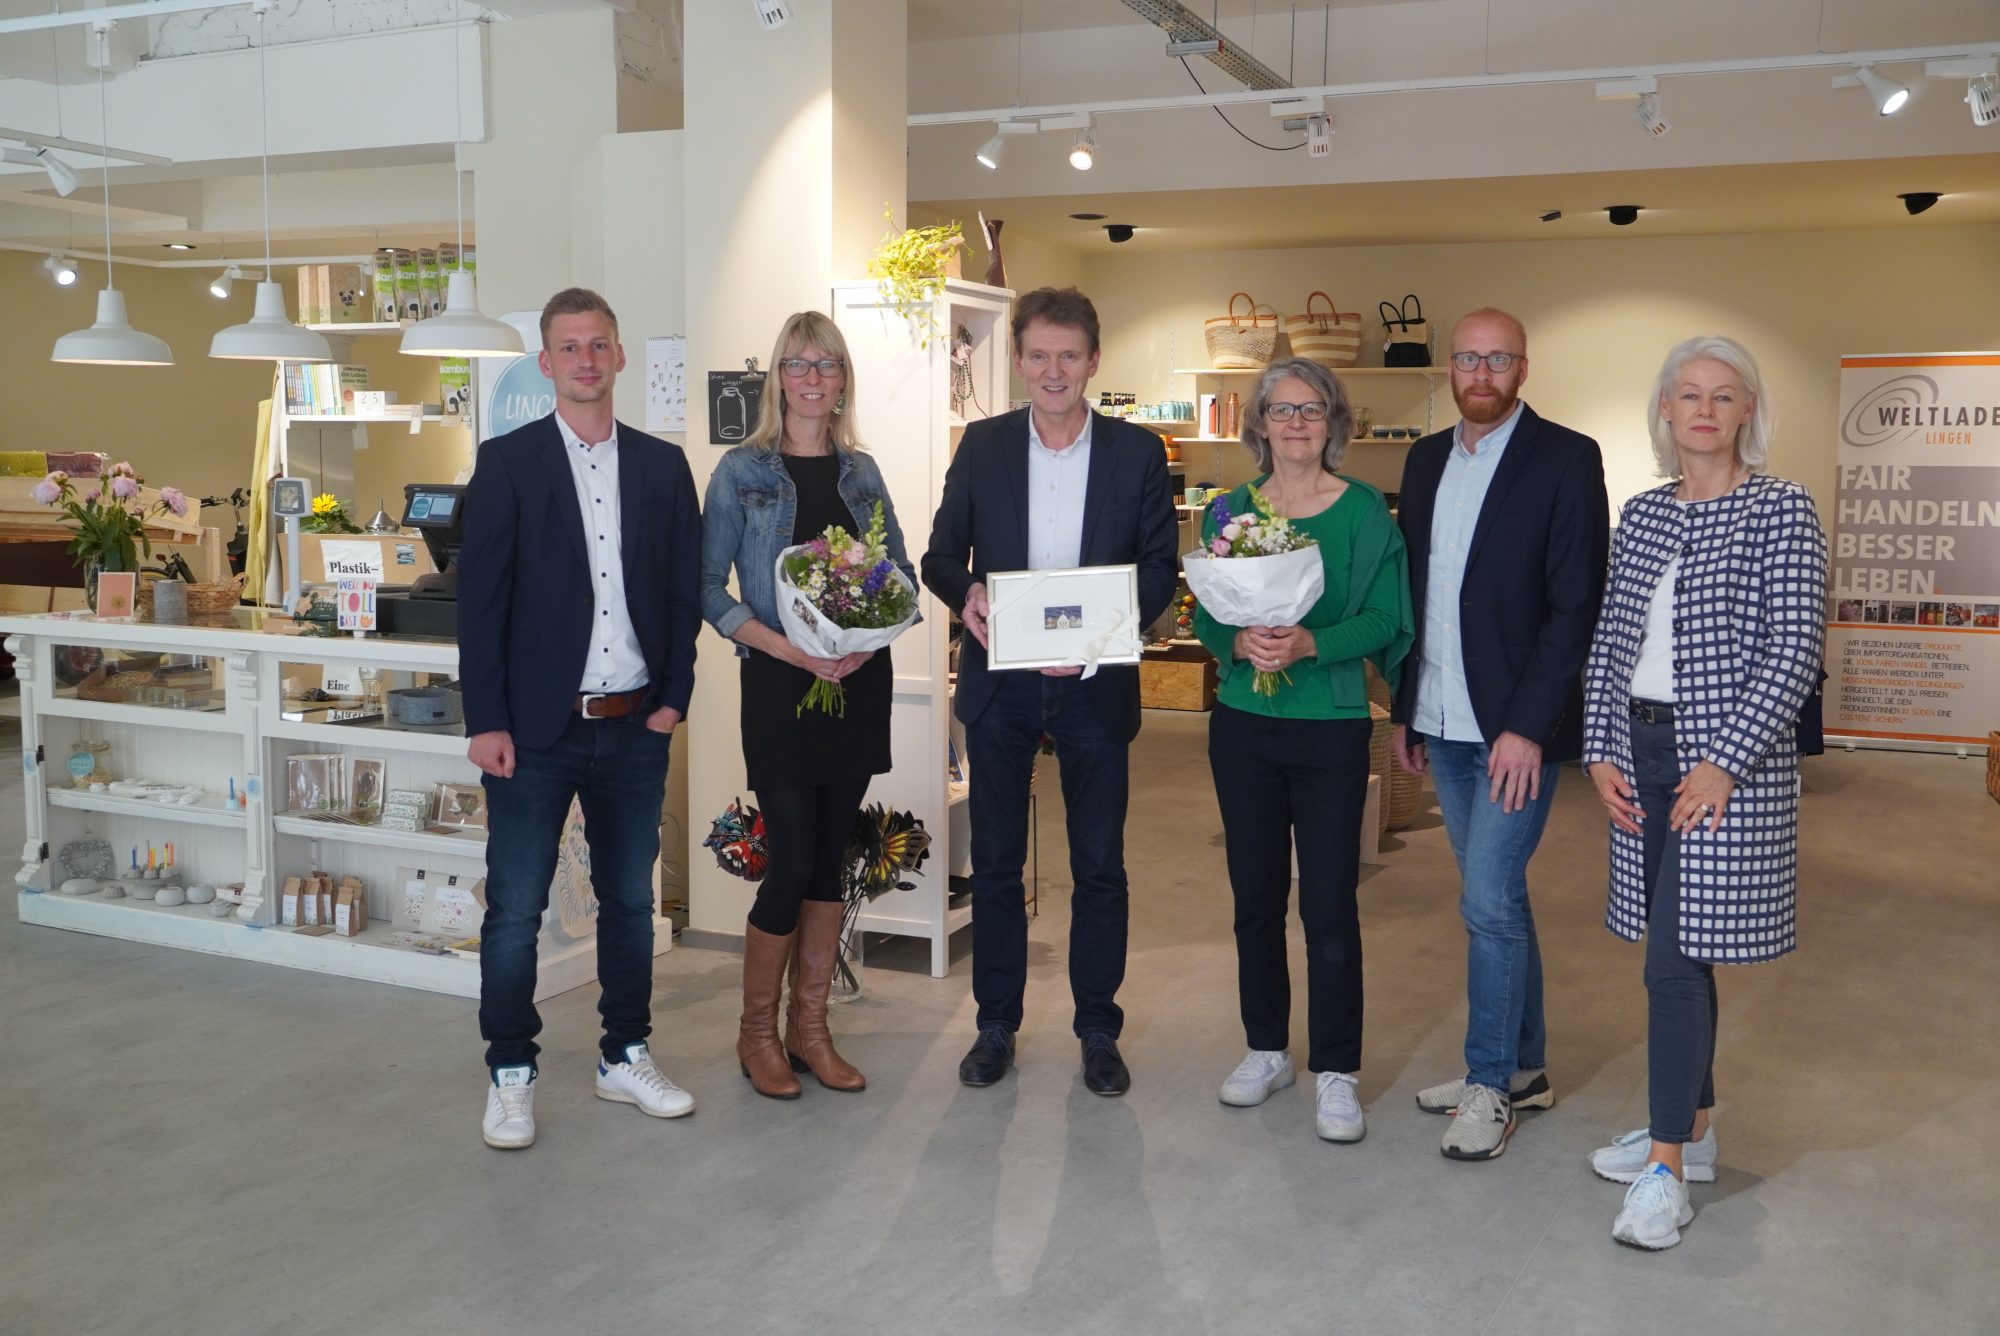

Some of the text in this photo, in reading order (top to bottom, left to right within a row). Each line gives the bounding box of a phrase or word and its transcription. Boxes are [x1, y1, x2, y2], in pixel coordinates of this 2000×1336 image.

[1878, 406, 2000, 426] WELTLADE
[1925, 432, 1971, 445] LINGEN
[1840, 464, 1912, 490] FAIR
[1838, 499, 2000, 527] HANDELN
[1837, 533, 1956, 561] BESSER
[339, 592, 374, 613] TOLL
[1842, 667, 1945, 679] ALLE WAREN WERDEN UNTER
[327, 680, 350, 690] Eine
[1840, 686, 1888, 695] HERGESTELLT
[1890, 688, 1906, 696] UND
[1919, 689, 1948, 698] PREISEN
